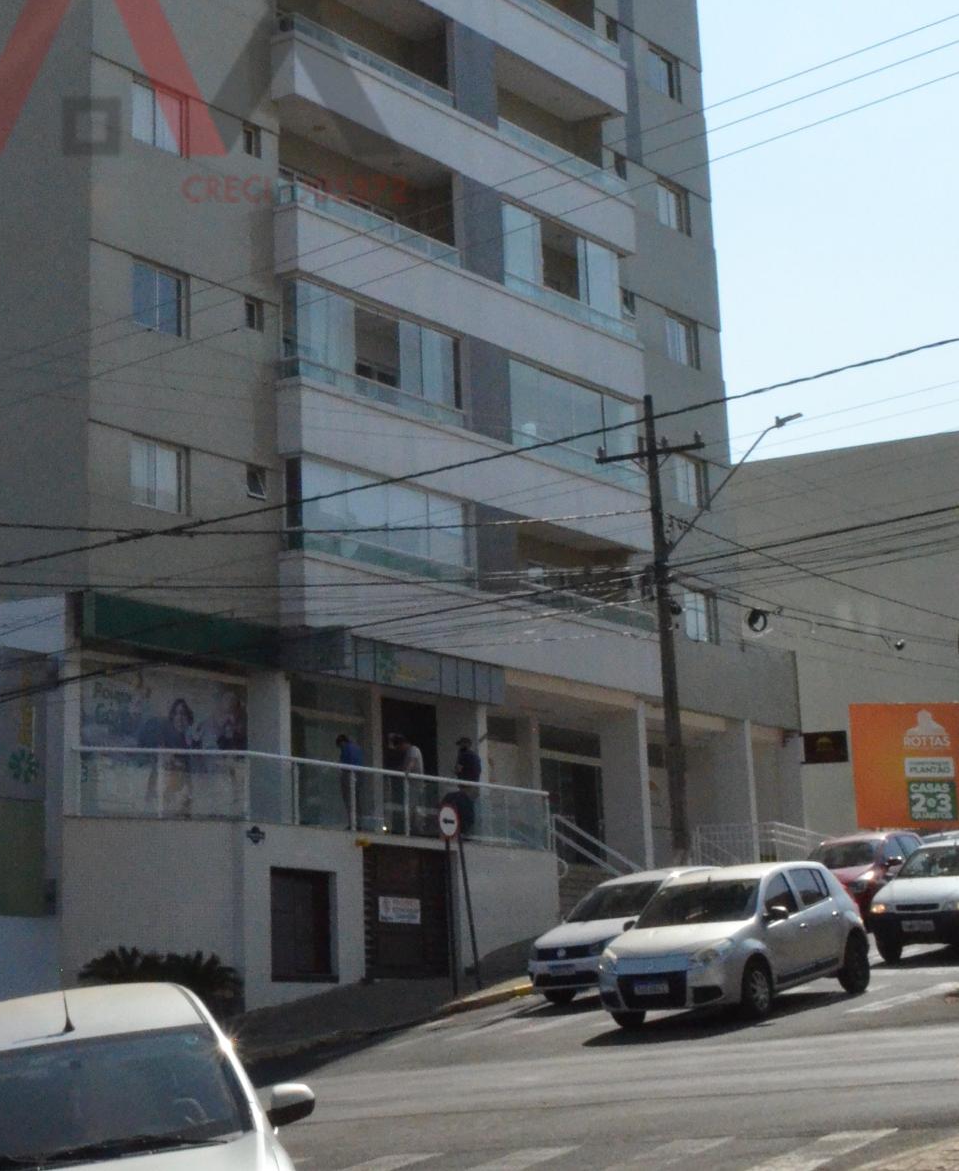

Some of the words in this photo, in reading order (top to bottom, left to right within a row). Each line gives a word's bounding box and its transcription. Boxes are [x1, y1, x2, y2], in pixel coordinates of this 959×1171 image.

[903, 735, 951, 747] ROTTAS
[910, 782, 951, 793] CASAS
[911, 793, 928, 812] 2
[936, 793, 953, 812] 3
